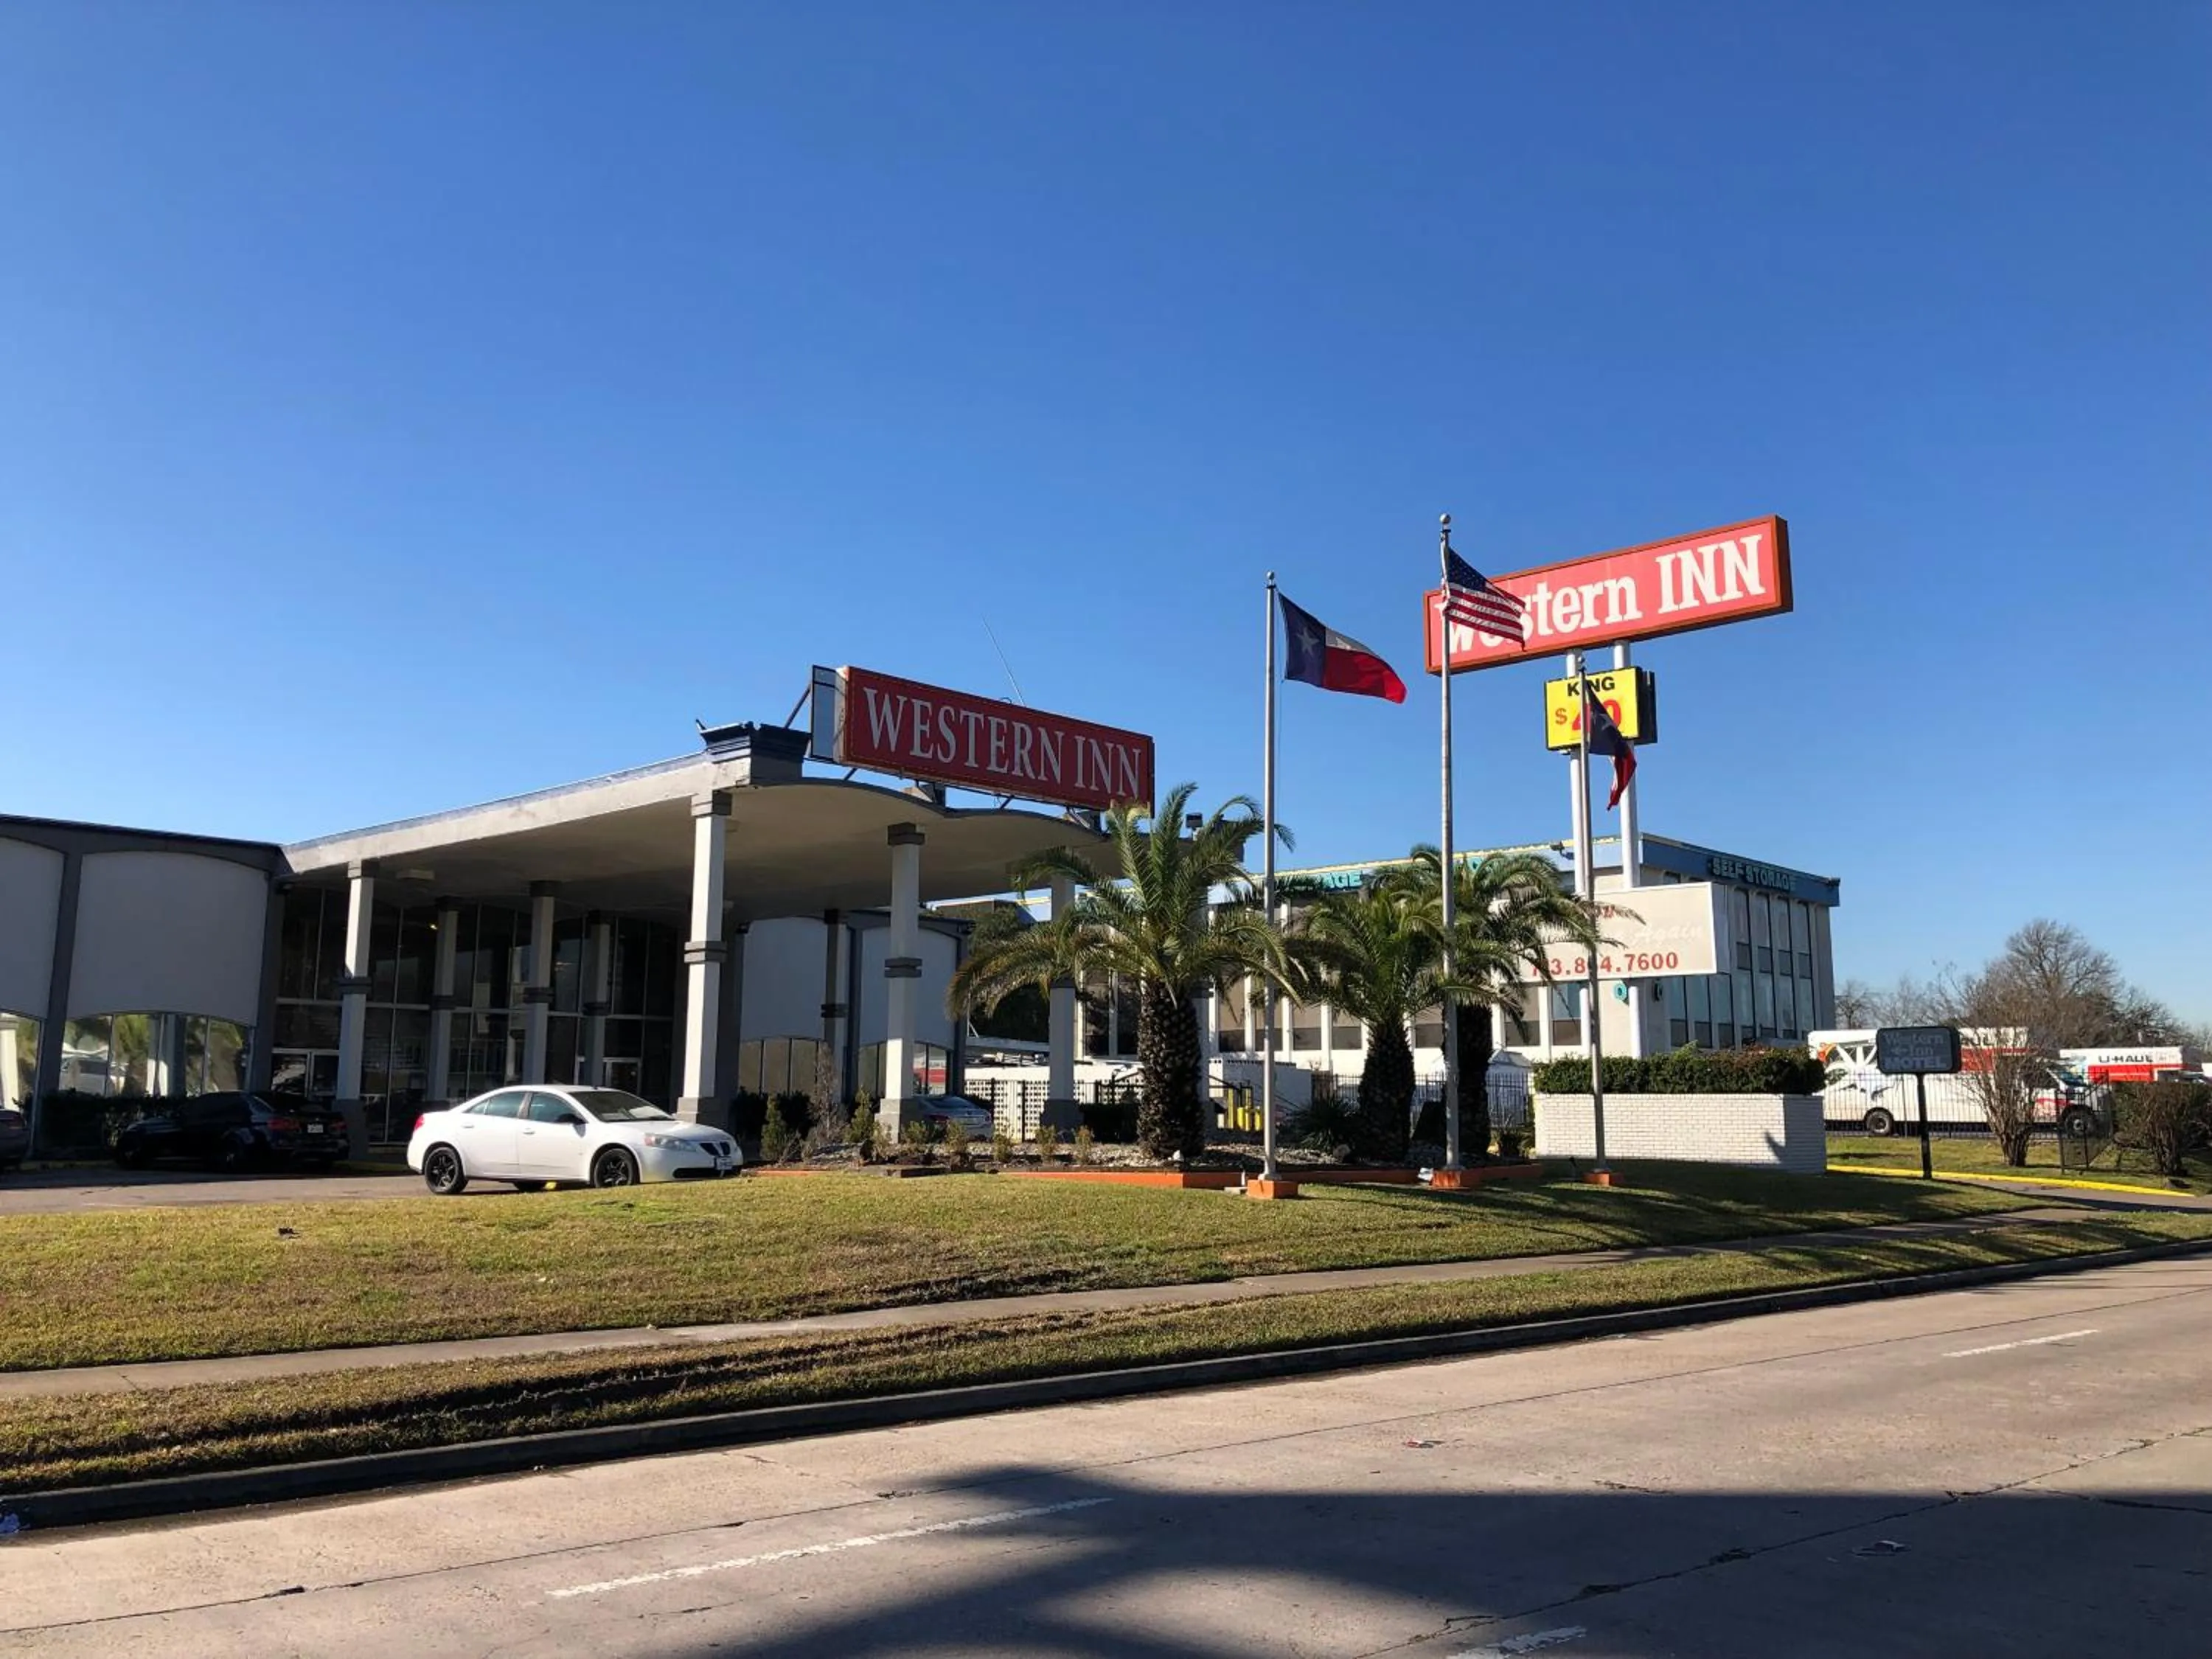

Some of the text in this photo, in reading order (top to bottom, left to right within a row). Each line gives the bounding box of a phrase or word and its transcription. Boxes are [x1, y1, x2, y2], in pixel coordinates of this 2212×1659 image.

[1655, 534, 1767, 614] INN
[1568, 676, 1615, 697] KNG
[863, 686, 1141, 798] WESTERN INN
[1713, 858, 1744, 879] SELF
[1532, 952, 1678, 976] 3.84.7600
